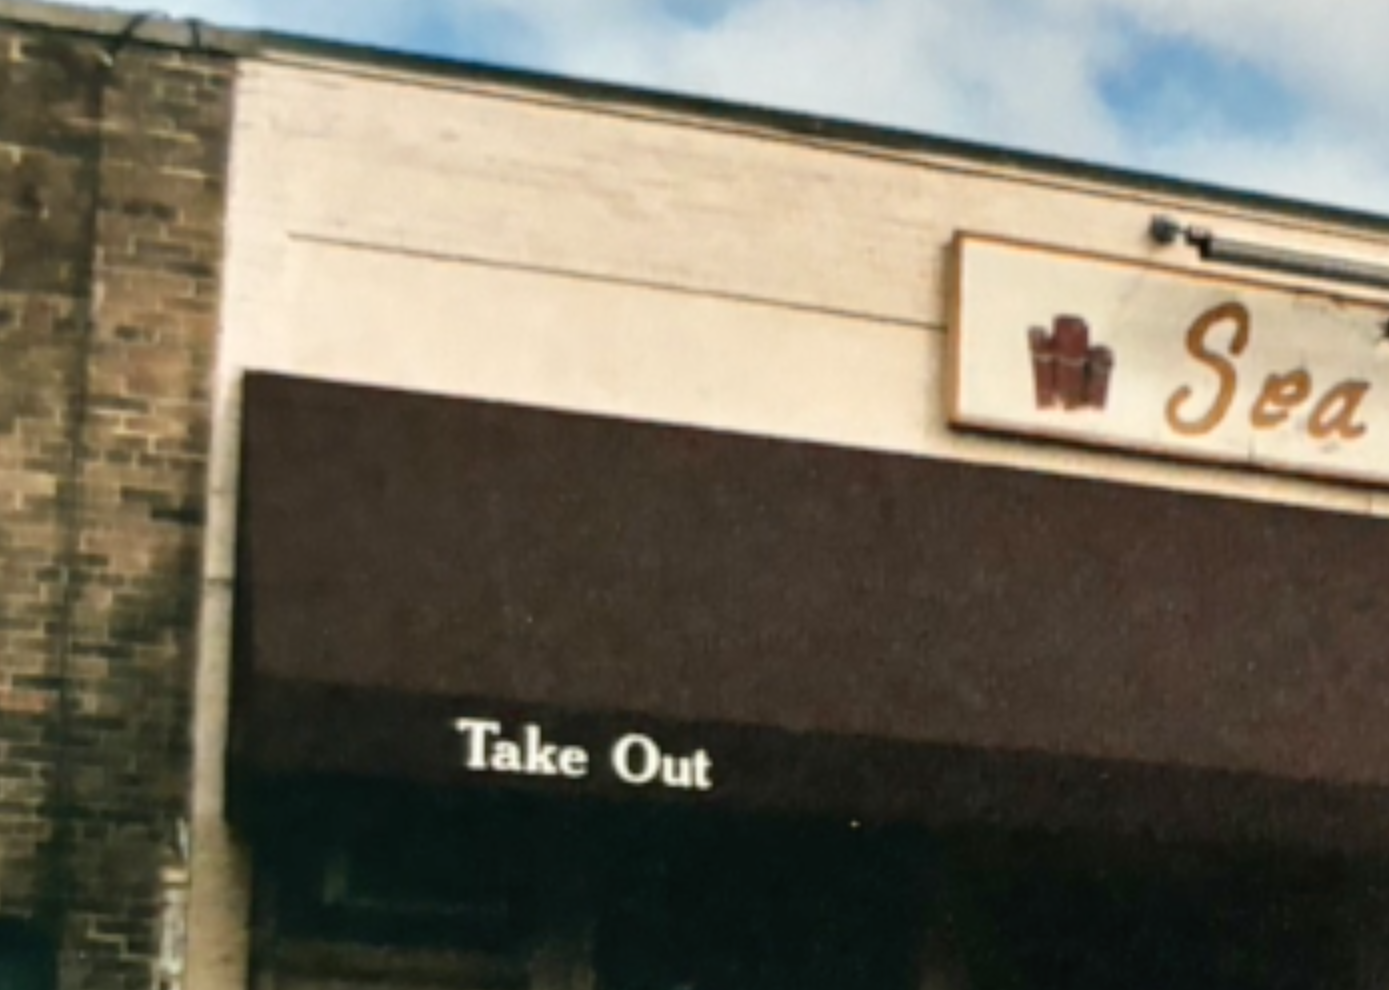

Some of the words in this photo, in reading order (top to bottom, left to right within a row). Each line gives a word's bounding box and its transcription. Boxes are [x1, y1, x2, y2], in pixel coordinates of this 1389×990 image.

[1164, 300, 1371, 436] Sea
[455, 717, 589, 778] Take
[610, 732, 713, 789] Out
